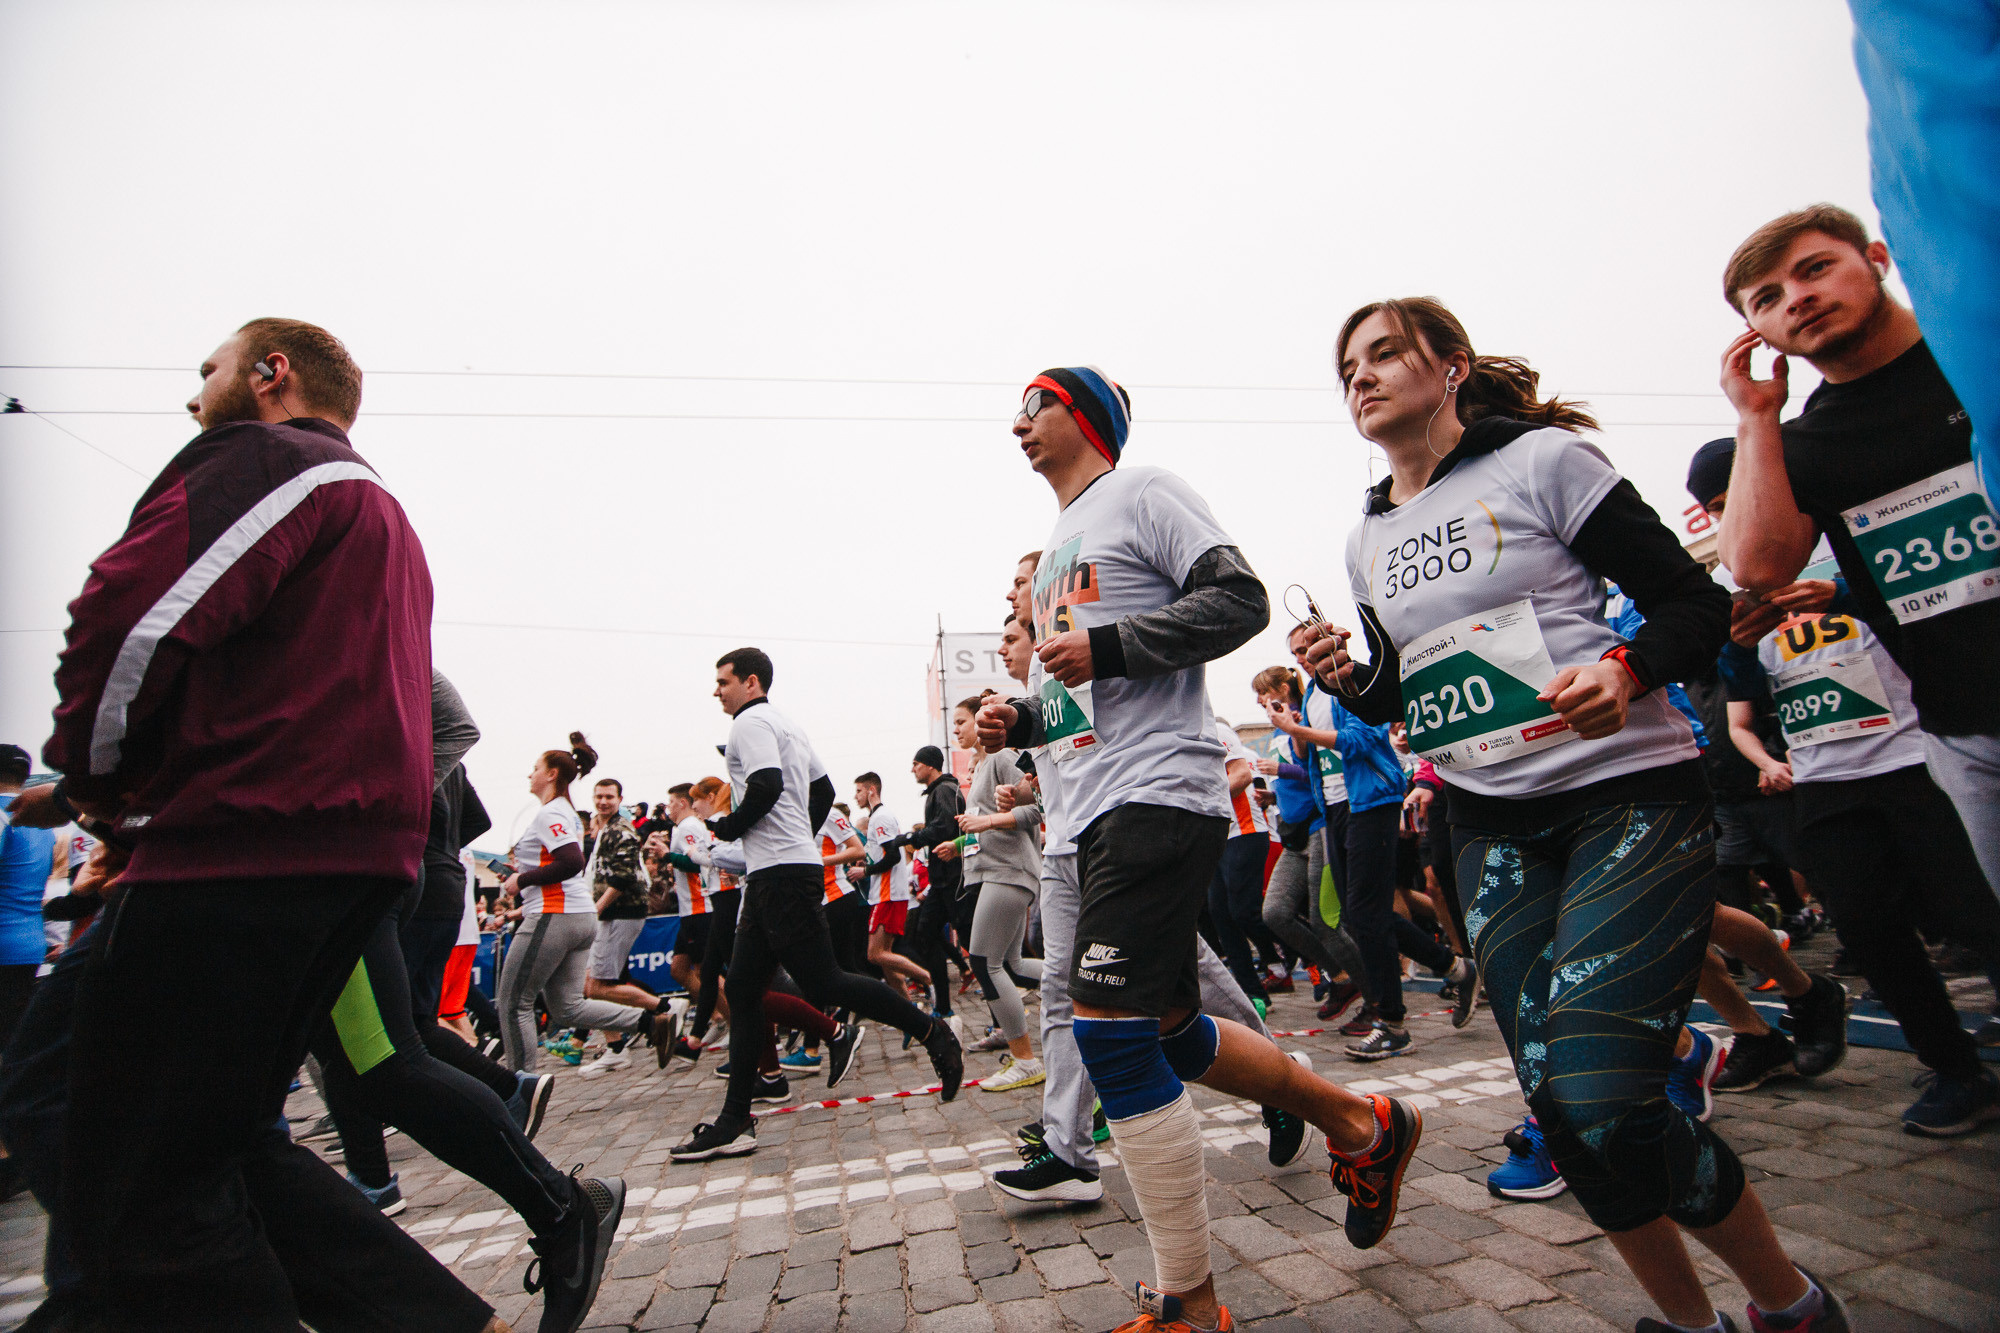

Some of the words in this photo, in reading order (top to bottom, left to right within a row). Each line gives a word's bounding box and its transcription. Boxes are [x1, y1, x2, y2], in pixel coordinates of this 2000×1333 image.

[1875, 480, 1960, 519] Жилстрой-1
[1387, 517, 1467, 572] ZONE
[1874, 515, 2000, 583] 2368
[1385, 547, 1472, 599] 3000
[1901, 599, 1921, 614] 10
[1407, 675, 1495, 737] 2520
[1780, 690, 1842, 724] 2899
[1488, 735, 1513, 745] TURKISH
[1490, 740, 1515, 750] AIRLINES
[1087, 943, 1120, 961] NIKE
[1078, 967, 1096, 982] TRACK
[1096, 973, 1103, 983] &
[1103, 974, 1126, 987] FIELD
